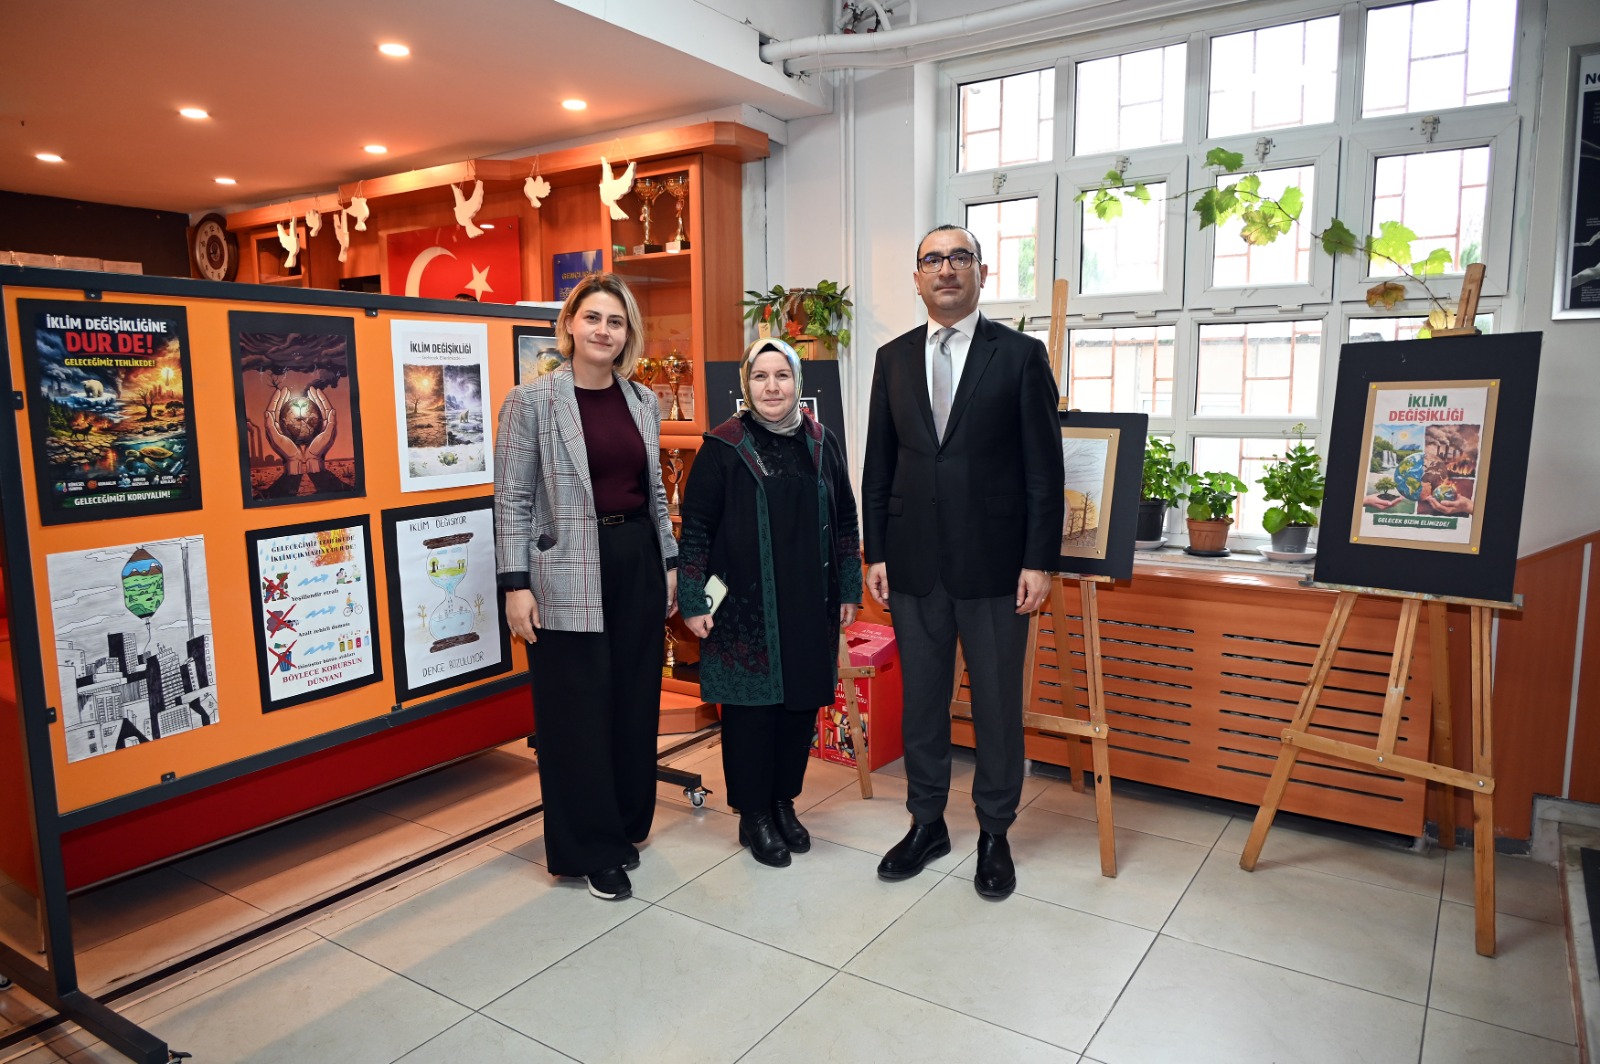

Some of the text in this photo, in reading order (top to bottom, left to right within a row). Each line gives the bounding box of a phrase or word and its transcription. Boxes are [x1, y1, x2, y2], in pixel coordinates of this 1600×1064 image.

[46, 313, 167, 333] İKLİM DEĞİŞİKLİĞİNE
[66, 332, 153, 354] DUR DE!
[409, 340, 472, 355] İKLİM DEĞİŞİKLİĞİ
[64, 357, 156, 367] GELECEĞİMİZ TEHLİKEDE!
[1407, 393, 1448, 408] İKLİM
[1388, 408, 1464, 423] DEĞİŞİKLİĞİ
[74, 494, 126, 506] GELECEĞİMİZİ
[282, 657, 363, 684] BÖYLECE KORURSUN
[306, 672, 342, 687] DÜNYANI
